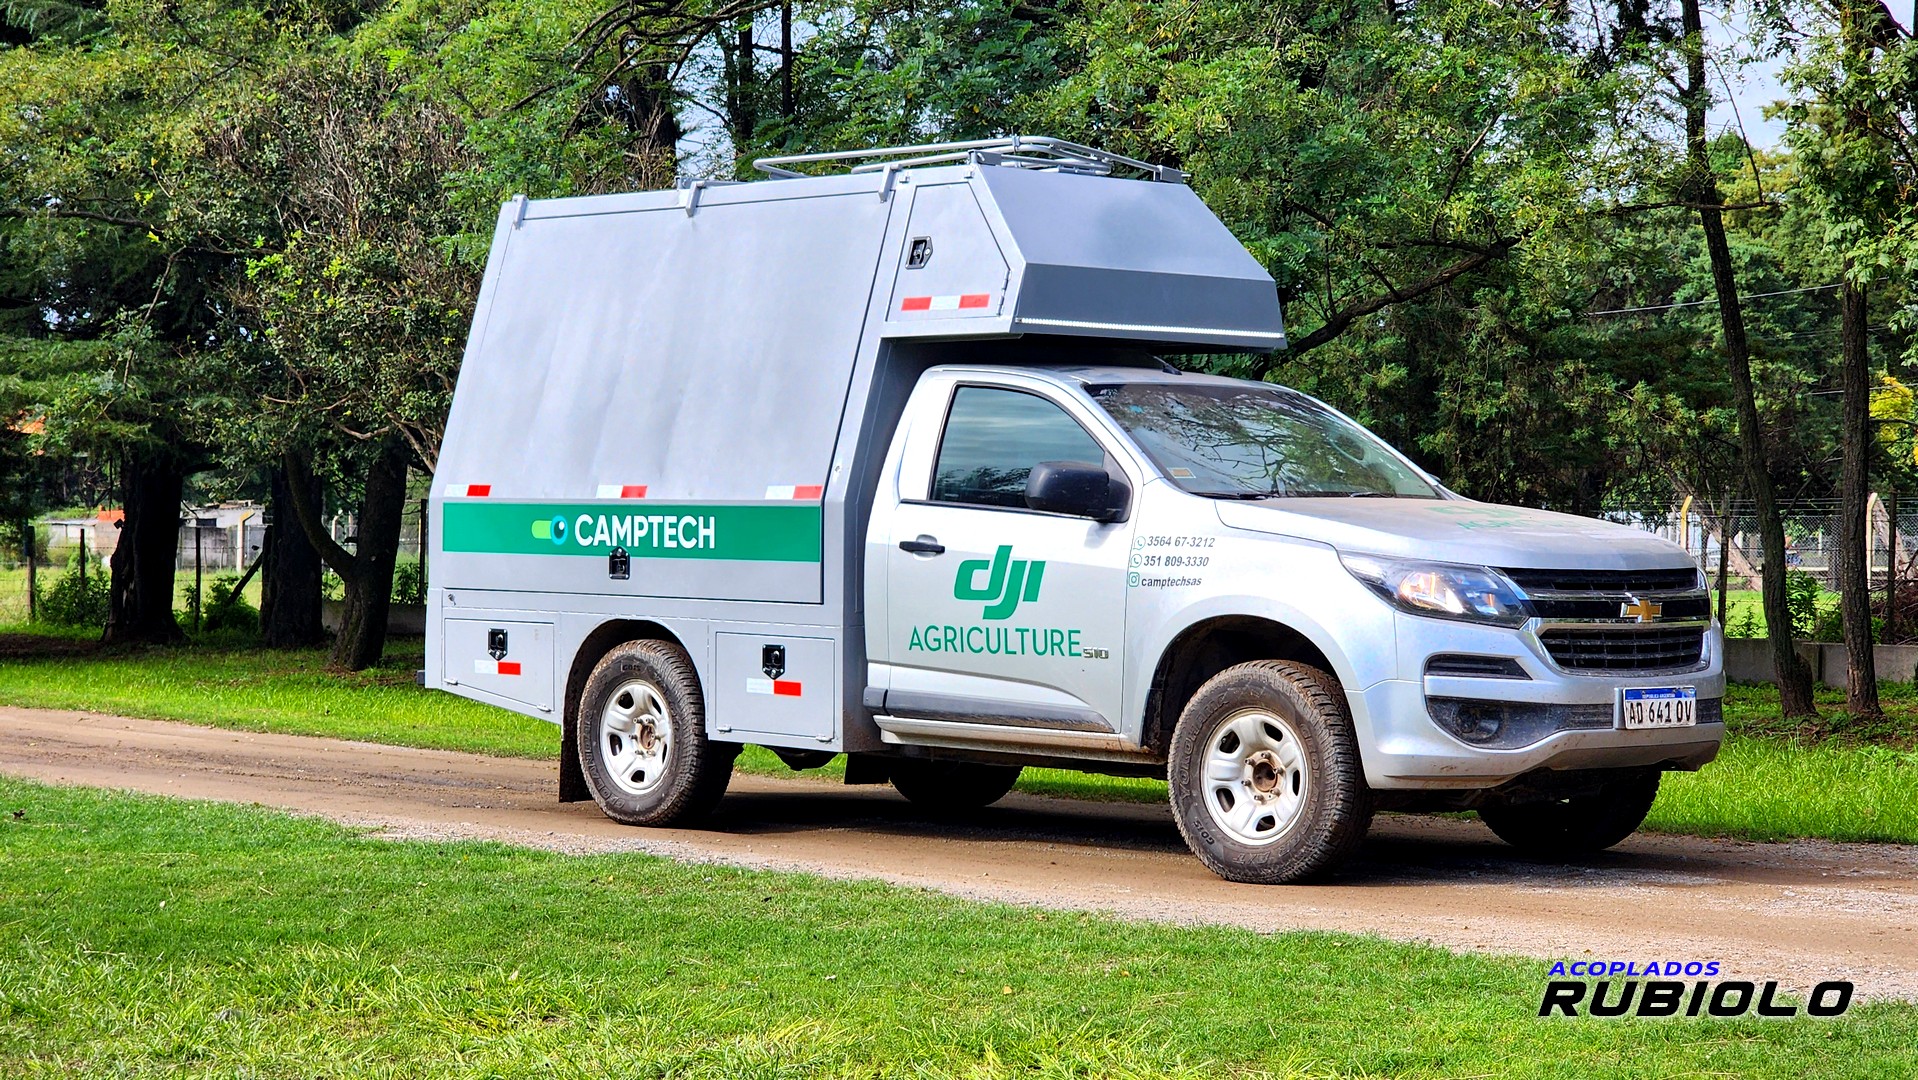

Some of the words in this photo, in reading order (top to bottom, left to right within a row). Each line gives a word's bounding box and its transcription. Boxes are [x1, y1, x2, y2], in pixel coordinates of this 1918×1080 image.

[575, 514, 716, 549] CAMPTECH
[1147, 536, 1172, 546] 3564
[1174, 536, 1216, 548] 67-3212
[1144, 556, 1162, 566] 351
[1164, 556, 1210, 566] 809-3330
[1141, 576, 1202, 590] camptechsas
[909, 625, 1082, 657] AGRICULTURE
[1083, 647, 1109, 660] S10
[1630, 702, 1643, 724] AD
[1648, 702, 1672, 723] 641
